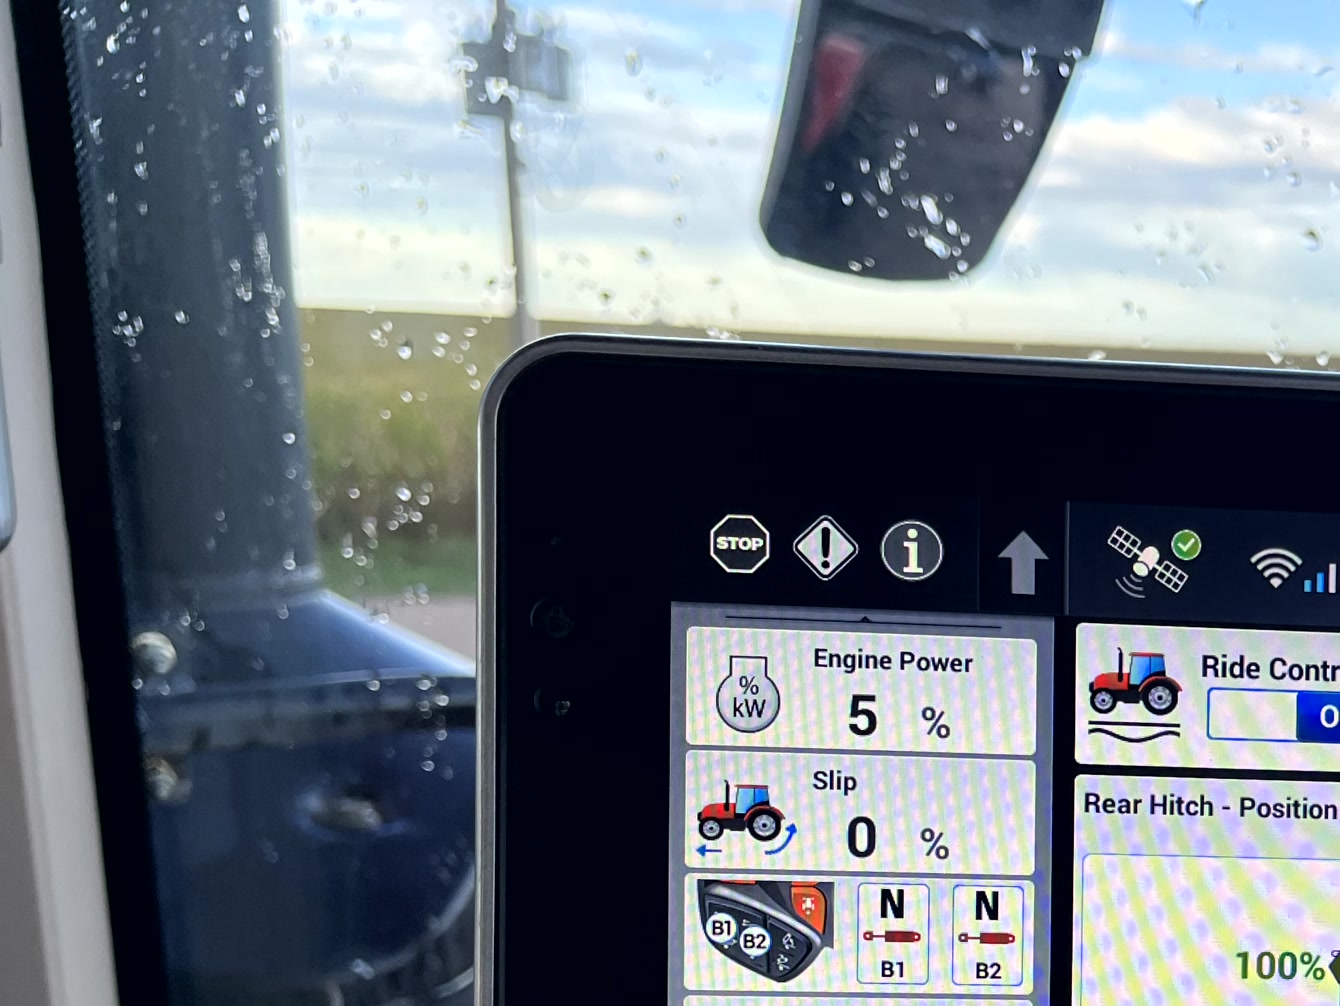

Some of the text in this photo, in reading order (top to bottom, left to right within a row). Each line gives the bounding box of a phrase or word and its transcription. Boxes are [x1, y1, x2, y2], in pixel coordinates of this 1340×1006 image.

[716, 537, 764, 551] STOP
[814, 649, 973, 673] Engine Power
[1201, 654, 1260, 679] Ride
[739, 676, 759, 695] %
[732, 698, 766, 718] kW
[848, 694, 951, 739] 5 %
[812, 771, 858, 795] Slip
[1084, 792, 1142, 814] Rear
[1149, 794, 1214, 816] Hitch
[1239, 798, 1338, 820] Position
[847, 816, 949, 860] 0 %
[880, 889, 904, 919] N
[975, 891, 999, 921] N
[711, 921, 732, 935] B1
[743, 935, 766, 948] B2
[881, 962, 904, 978] B1
[976, 964, 1001, 979] B2
[1235, 951, 1326, 981] 100%
